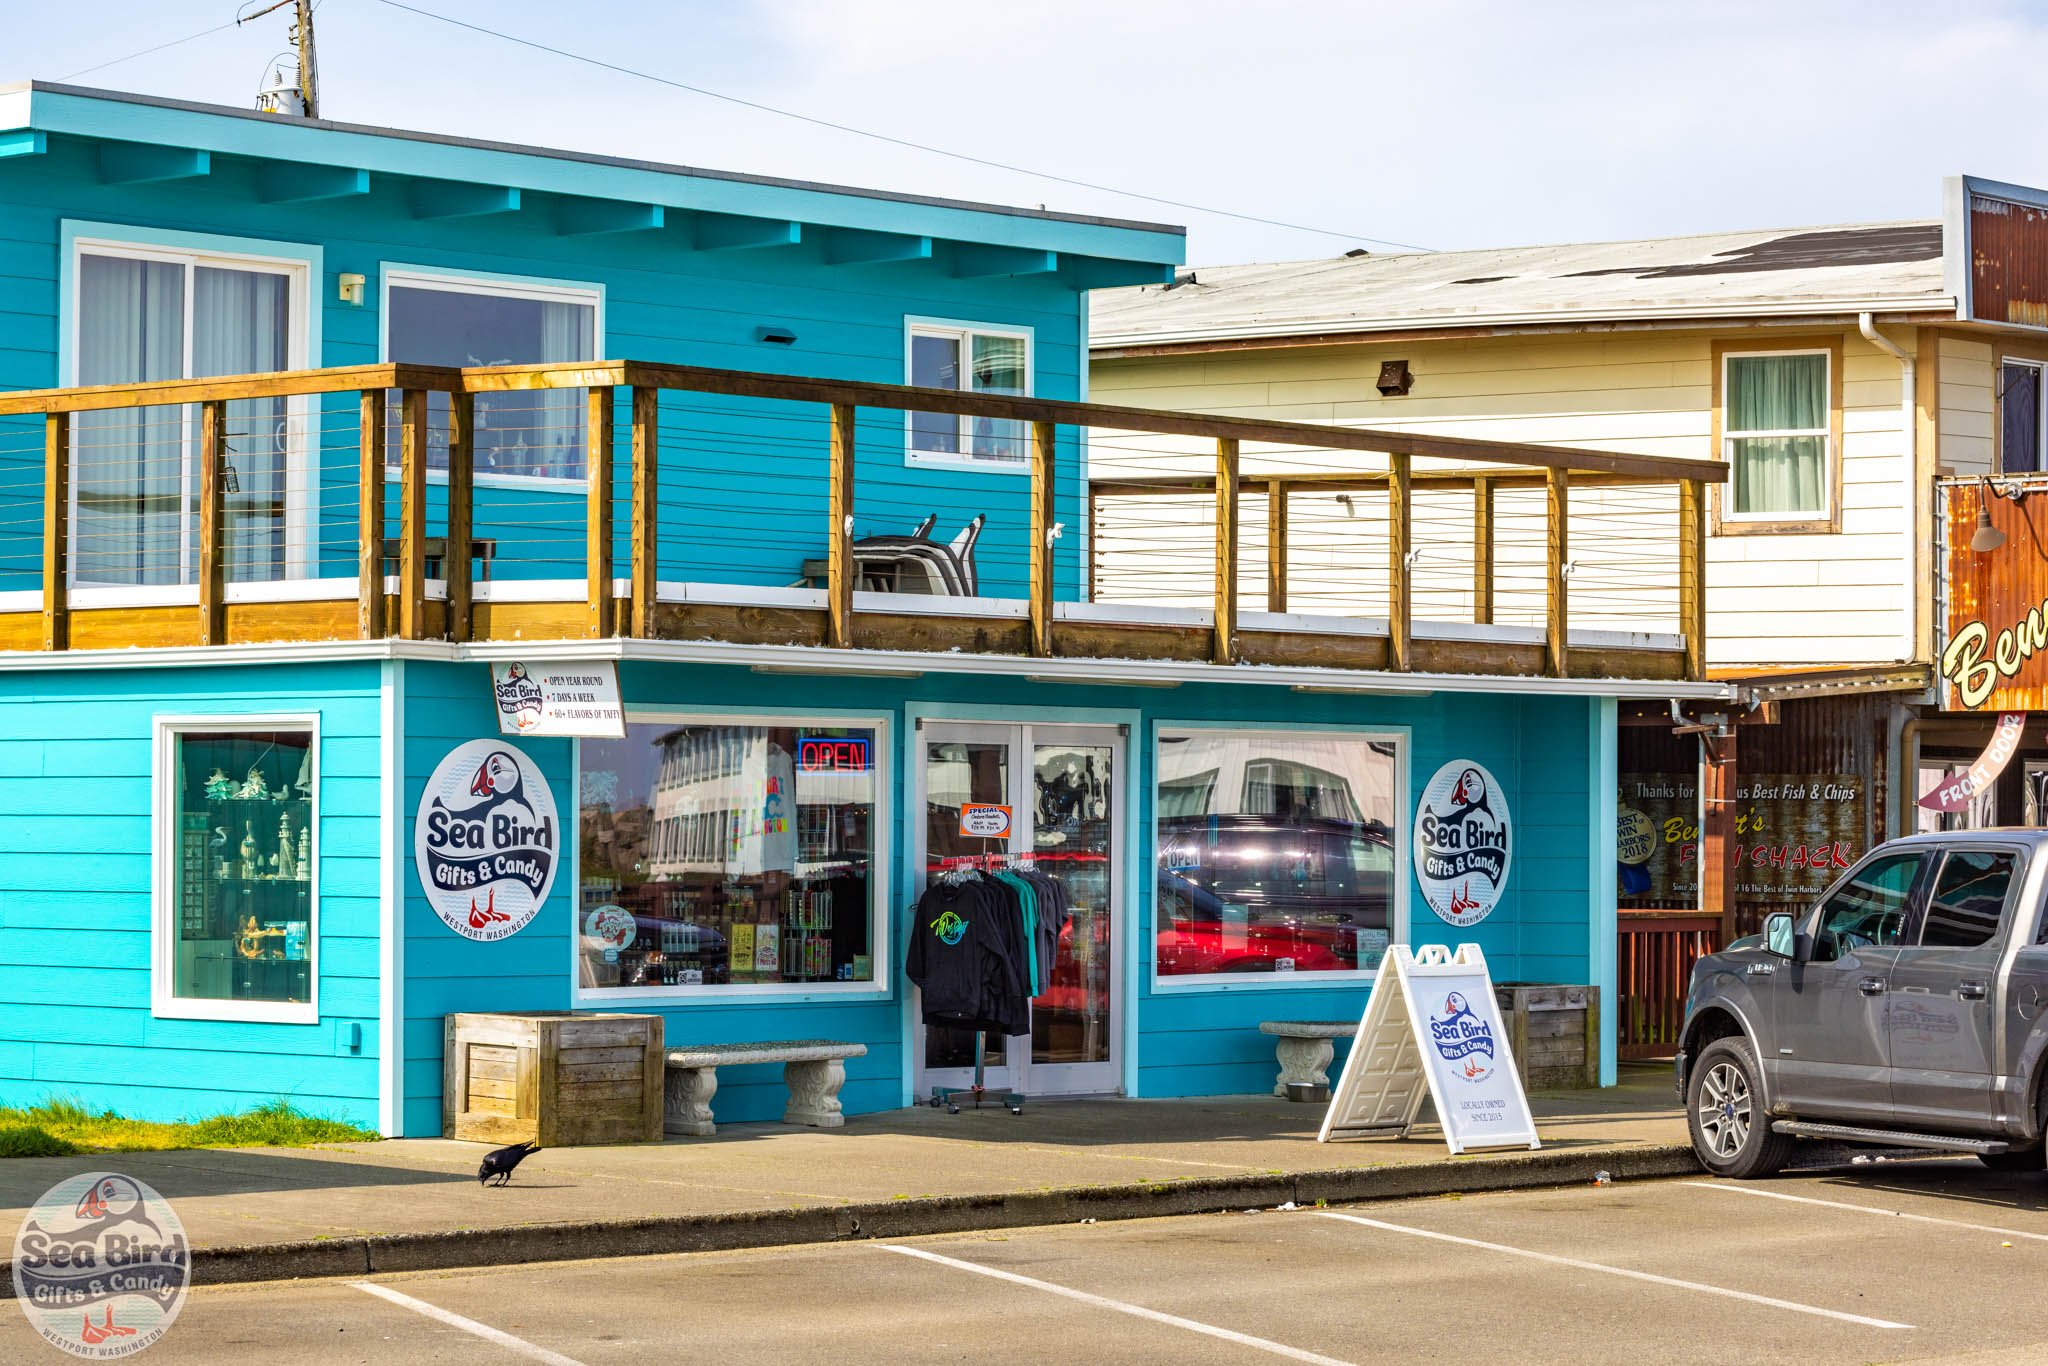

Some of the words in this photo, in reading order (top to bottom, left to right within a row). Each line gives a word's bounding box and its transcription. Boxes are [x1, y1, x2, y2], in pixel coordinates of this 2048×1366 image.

[549, 676, 567, 686] OPEN
[566, 676, 581, 686] YEAR
[582, 676, 603, 686] ROUND
[496, 684, 518, 698] Sea
[518, 684, 543, 698] Bird
[551, 693, 556, 703] 7
[556, 693, 571, 703] DAYS
[572, 693, 578, 703] A
[578, 693, 596, 703] WEEK
[554, 709, 566, 719] 60+
[567, 709, 593, 719] FLAVORS
[594, 709, 602, 719] OF
[603, 709, 620, 720] TAFFY
[802, 743, 865, 772] OPEN
[1938, 763, 1992, 807] FRONT
[1988, 713, 2020, 764] DOOR
[1636, 783, 1675, 798] Thanks
[1679, 783, 1695, 798] for
[1752, 784, 1779, 799] Best
[1782, 784, 1805, 799] Fish
[1810, 784, 1820, 799] &
[1824, 784, 1855, 802] Chips
[427, 811, 486, 849] Sea
[492, 814, 552, 850] Bird
[1421, 816, 1461, 849] Sea
[1465, 820, 1506, 850] Bird
[1617, 825, 1637, 837] WIN
[1617, 834, 1650, 848] ARBORS
[1623, 843, 1648, 858] 2018
[1170, 851, 1199, 867] OPEN
[1751, 842, 1851, 870] SHACK
[435, 863, 476, 886] Gifts
[478, 861, 493, 880] &
[495, 855, 543, 887] Candy
[1426, 857, 1454, 876] Gifts
[1455, 856, 1466, 873] &
[1466, 852, 1500, 880] Candy
[1672, 882, 1688, 891] Since
[1689, 882, 1698, 891] 20
[1741, 884, 1750, 893] 16
[1752, 884, 1762, 893] The
[1763, 884, 1777, 893] Best
[1778, 884, 1784, 893] of
[1785, 884, 1798, 893] Twin
[1429, 896, 1456, 924] WESTPORT
[1457, 903, 1493, 925] WASHINGTON
[443, 911, 483, 940] WESTPORT
[486, 909, 536, 940] WASHINGTON
[1431, 1022, 1460, 1040] Sea
[1459, 1020, 1492, 1040] Bird
[1441, 1046, 1462, 1060] Gifts
[1461, 1044, 1468, 1055] &
[1467, 1040, 1492, 1055] Candy
[1460, 1100, 1485, 1110] LOCALLY
[1485, 1099, 1505, 1109] OWNED
[1471, 1113, 1488, 1122] SINCE
